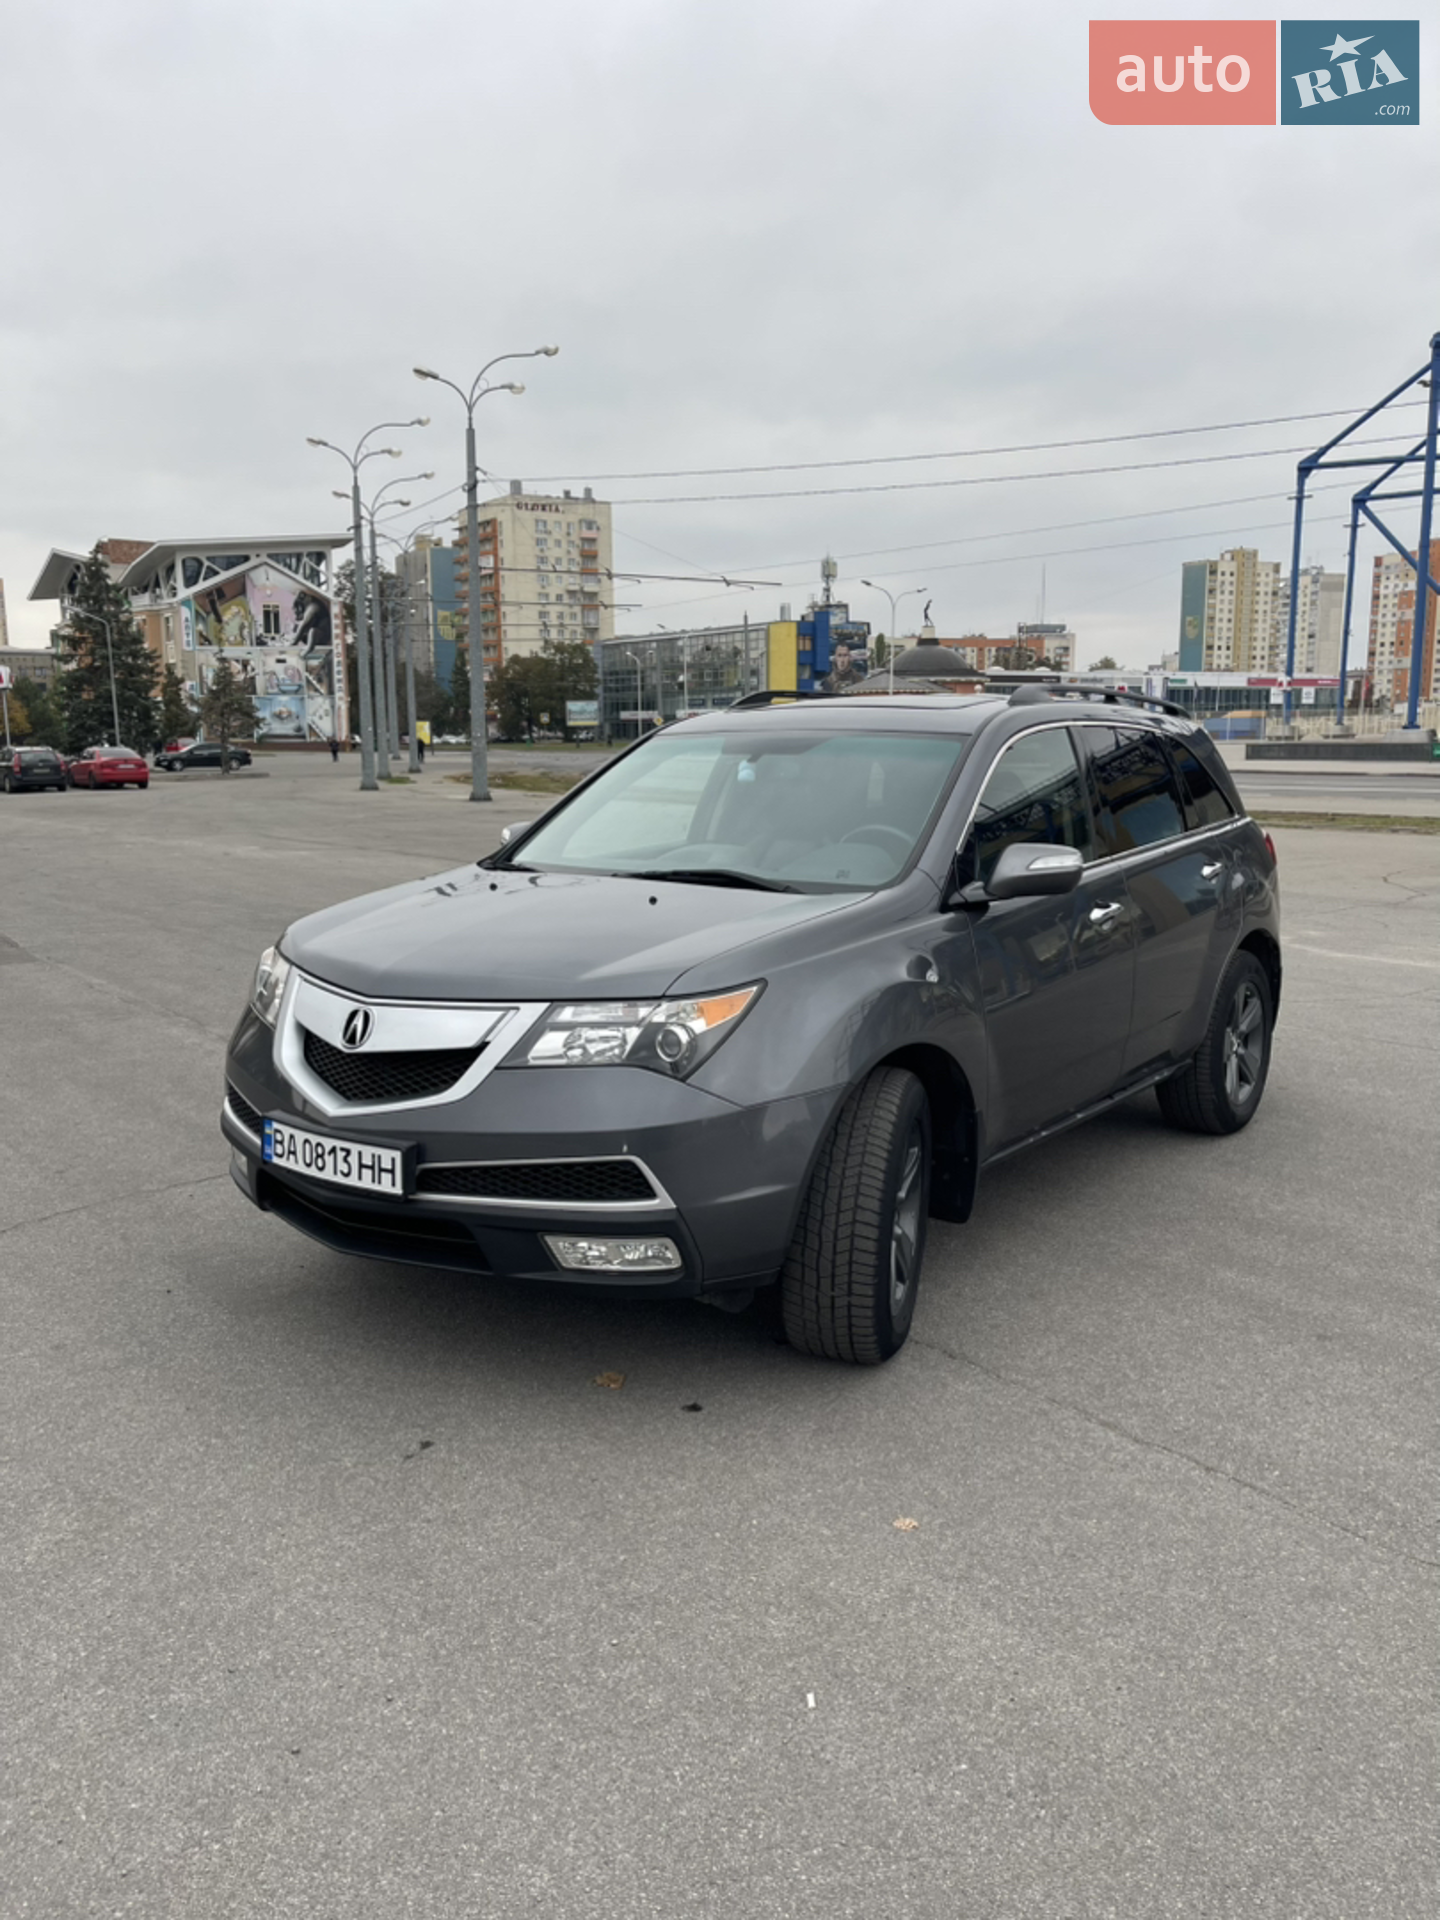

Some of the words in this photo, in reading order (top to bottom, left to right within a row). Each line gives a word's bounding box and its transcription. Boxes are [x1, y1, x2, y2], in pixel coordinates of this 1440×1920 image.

[273, 1128, 298, 1165] BA
[302, 1138, 352, 1178] 0813
[358, 1150, 396, 1188] HH
